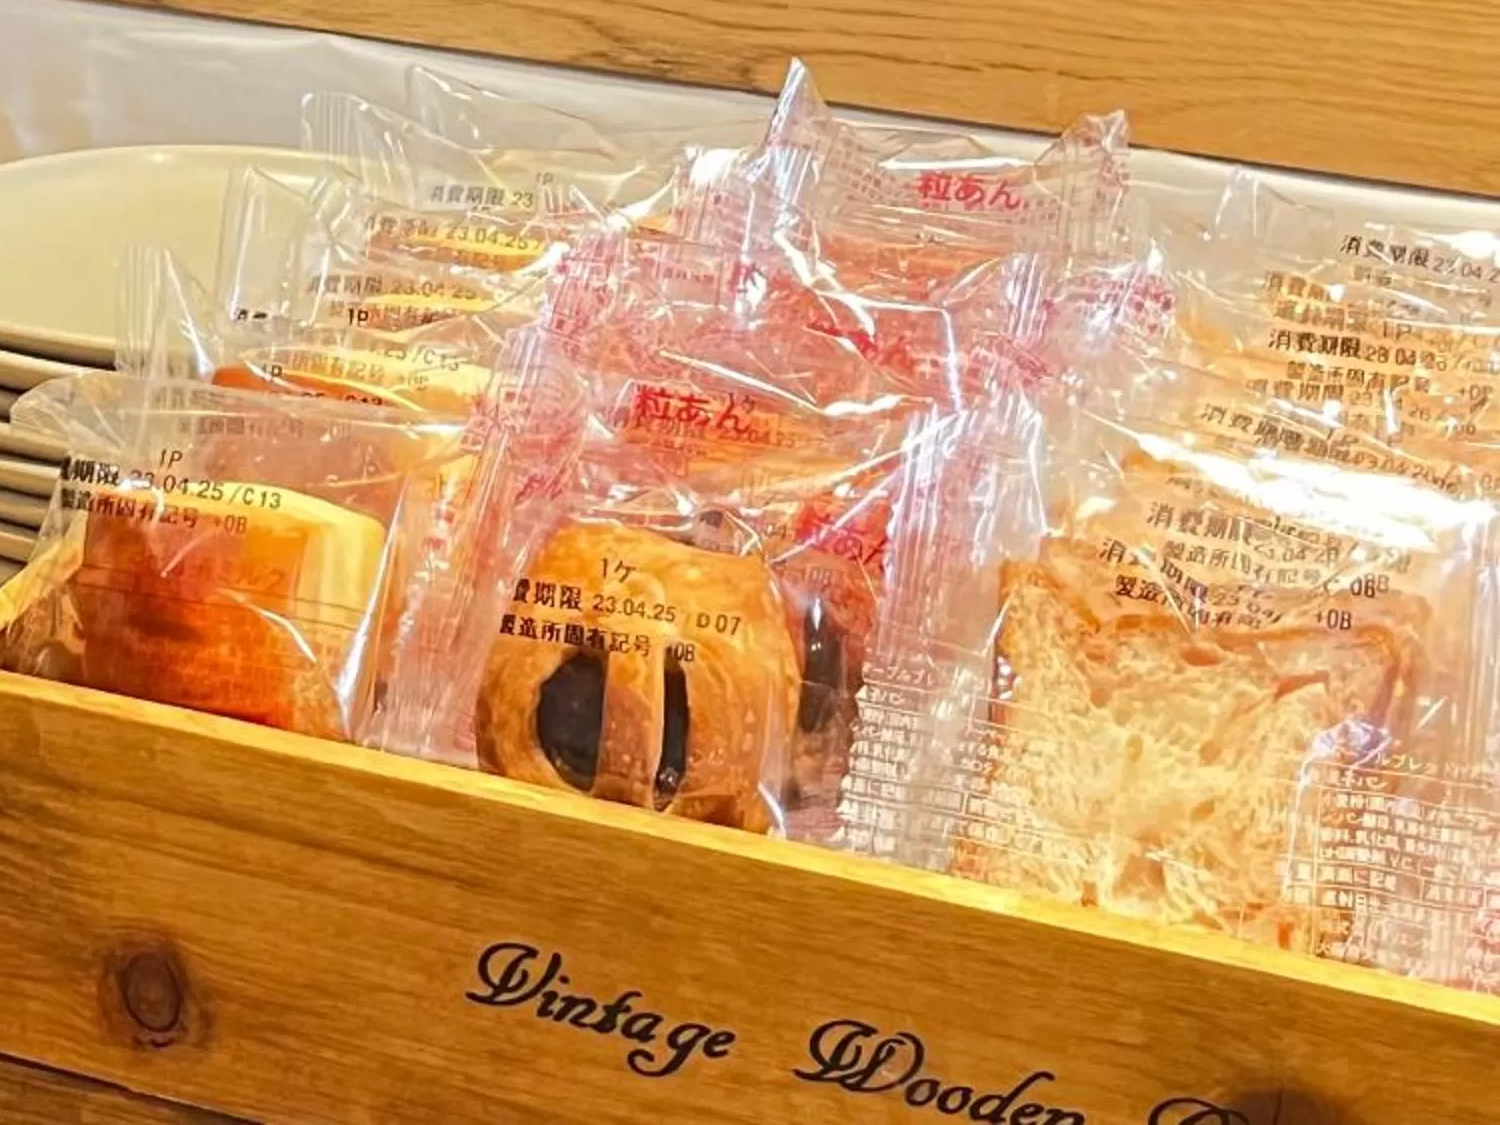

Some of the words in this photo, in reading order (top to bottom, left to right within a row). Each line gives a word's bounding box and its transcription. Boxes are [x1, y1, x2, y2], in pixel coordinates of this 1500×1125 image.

[917, 170, 1023, 211] 粒あん
[348, 308, 370, 326] 1P
[635, 384, 752, 434] 粒あん
[159, 448, 183, 466] 1P
[599, 557, 637, 584] 1ケ
[591, 593, 677, 623] 23.04.25
[465, 941, 737, 1077] Vintage
[793, 1019, 1087, 1125] Wooden
